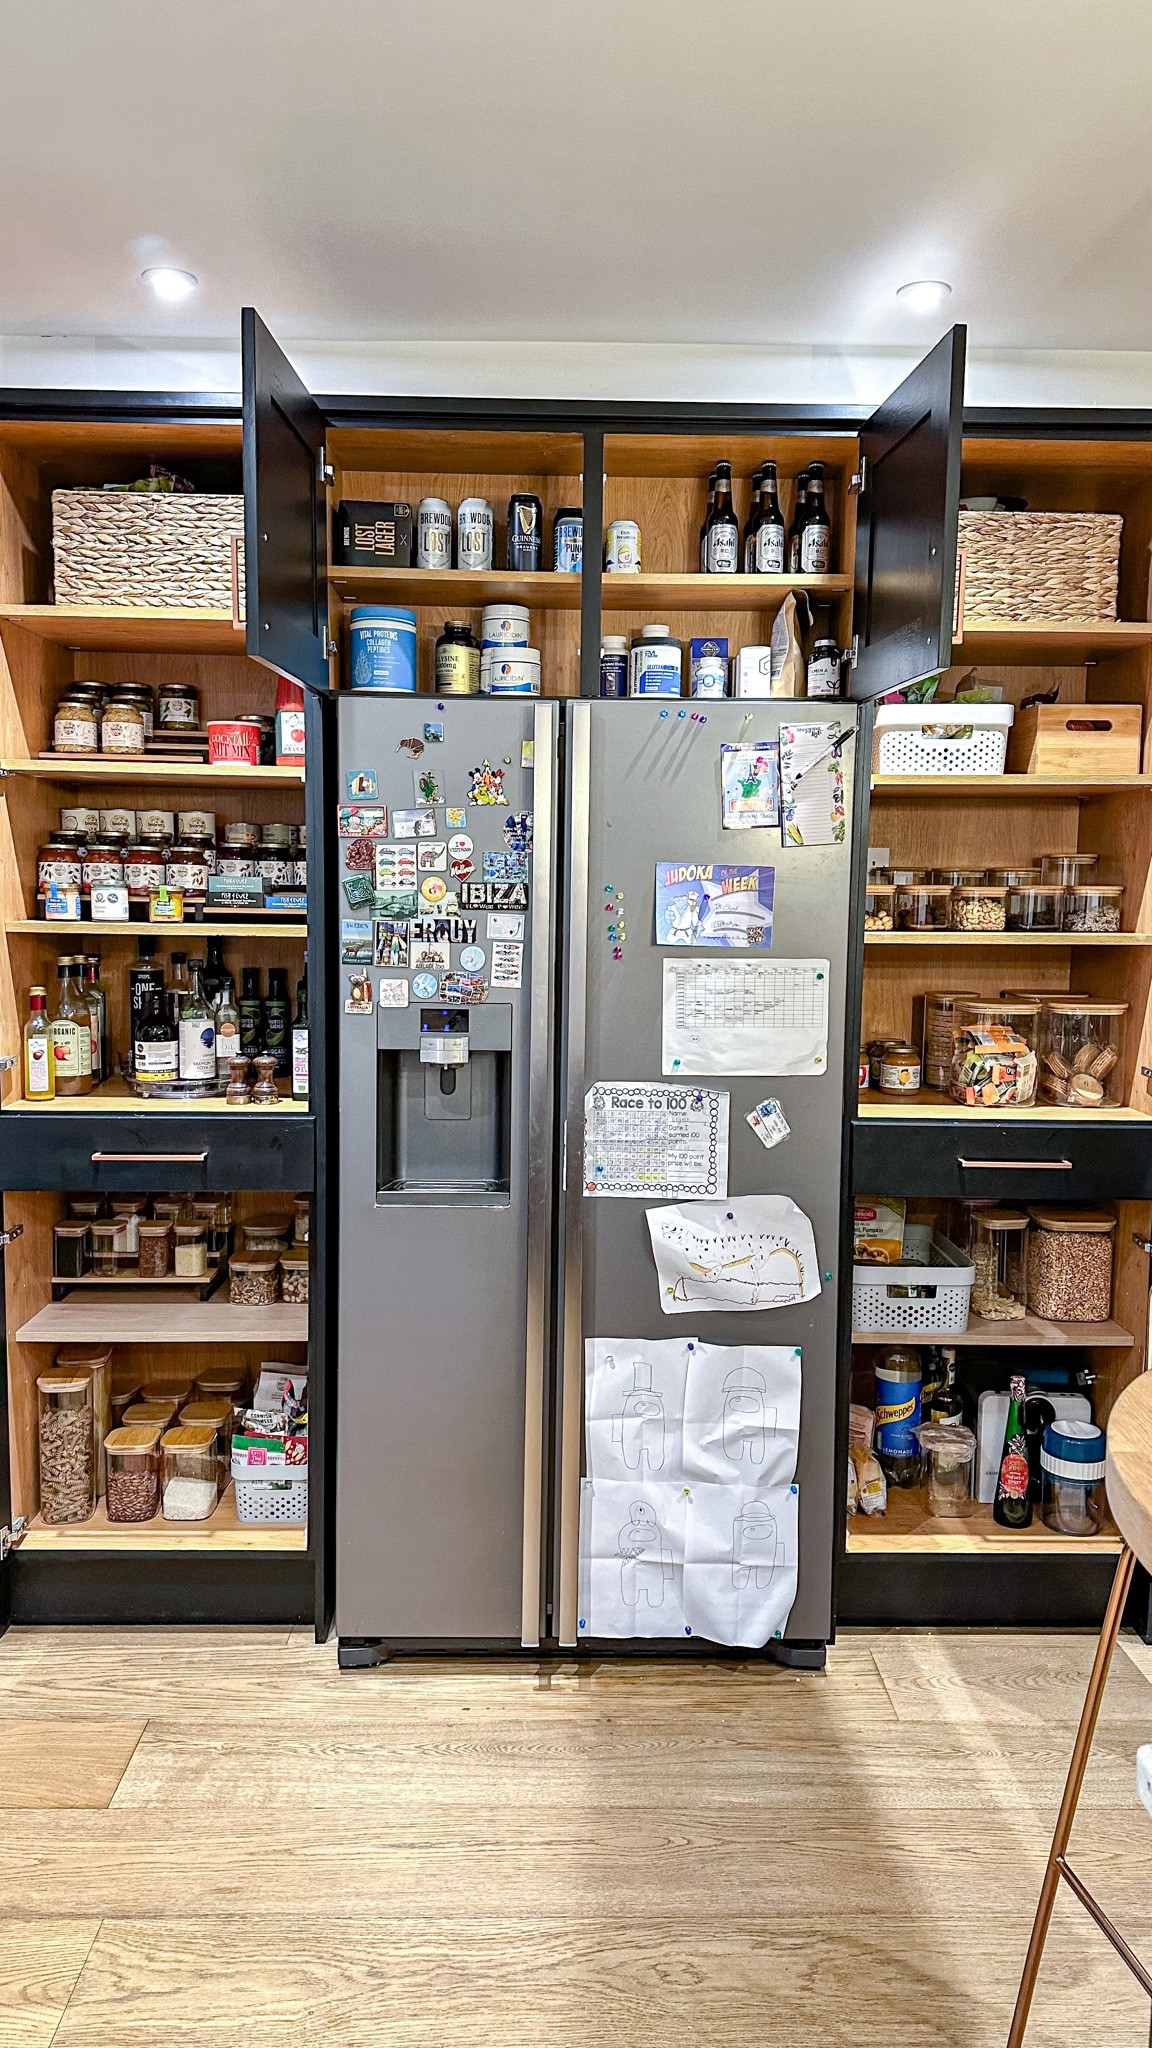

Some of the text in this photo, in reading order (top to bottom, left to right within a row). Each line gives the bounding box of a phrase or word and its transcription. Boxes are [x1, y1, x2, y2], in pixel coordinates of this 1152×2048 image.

[355, 523, 375, 551] LOST
[375, 521, 395, 556] LAGER
[512, 535, 541, 544] GUINNESS
[559, 526, 582, 538] BREWD
[424, 531, 450, 553] LOST
[462, 532, 487, 552] LOST
[713, 537, 735, 547] Asahi
[763, 537, 783, 547] Asahi
[808, 537, 827, 548] Asahi
[571, 555, 579, 563] AF
[360, 631, 398, 641] VITAL PROTEINS
[212, 731, 250, 746] COCKTAIL
[212, 743, 250, 758] NUT MIX
[664, 865, 713, 886] JUDOKA
[721, 876, 758, 895] WEEK
[462, 883, 527, 904] IBIZA
[54, 1028, 76, 1036] RGANIC
[611, 1096, 687, 1109] Race to 100
[876, 1403, 914, 1422] Schweppes
